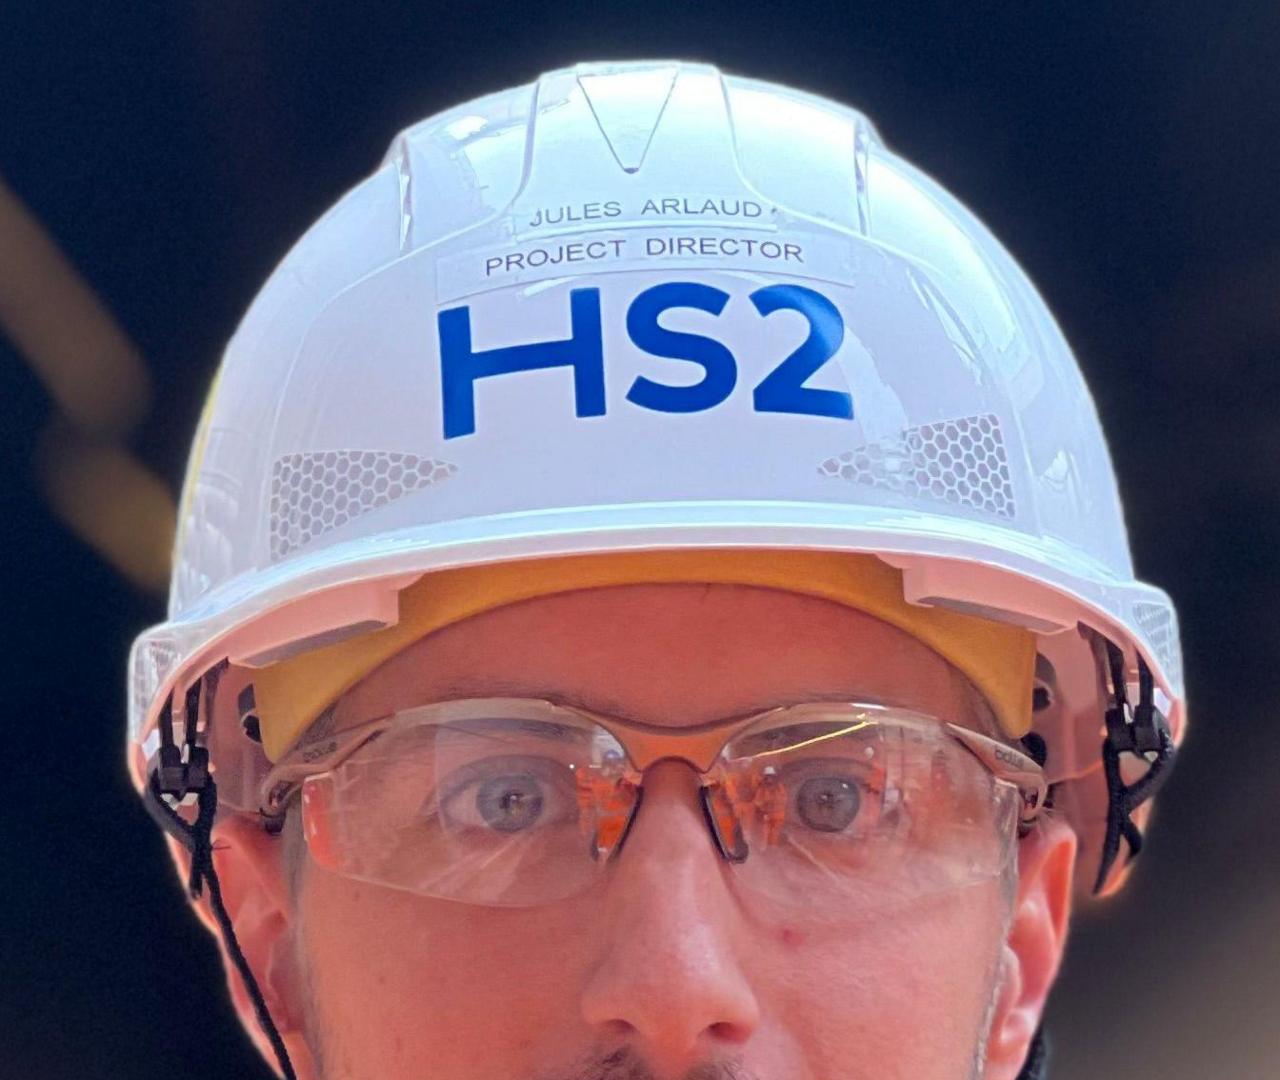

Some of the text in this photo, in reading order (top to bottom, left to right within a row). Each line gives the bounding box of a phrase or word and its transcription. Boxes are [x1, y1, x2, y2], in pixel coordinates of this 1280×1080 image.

[529, 198, 762, 228] JULES ARLAUD
[485, 237, 805, 277] PROJECT DIRECTOR
[437, 281, 855, 440] HS2
